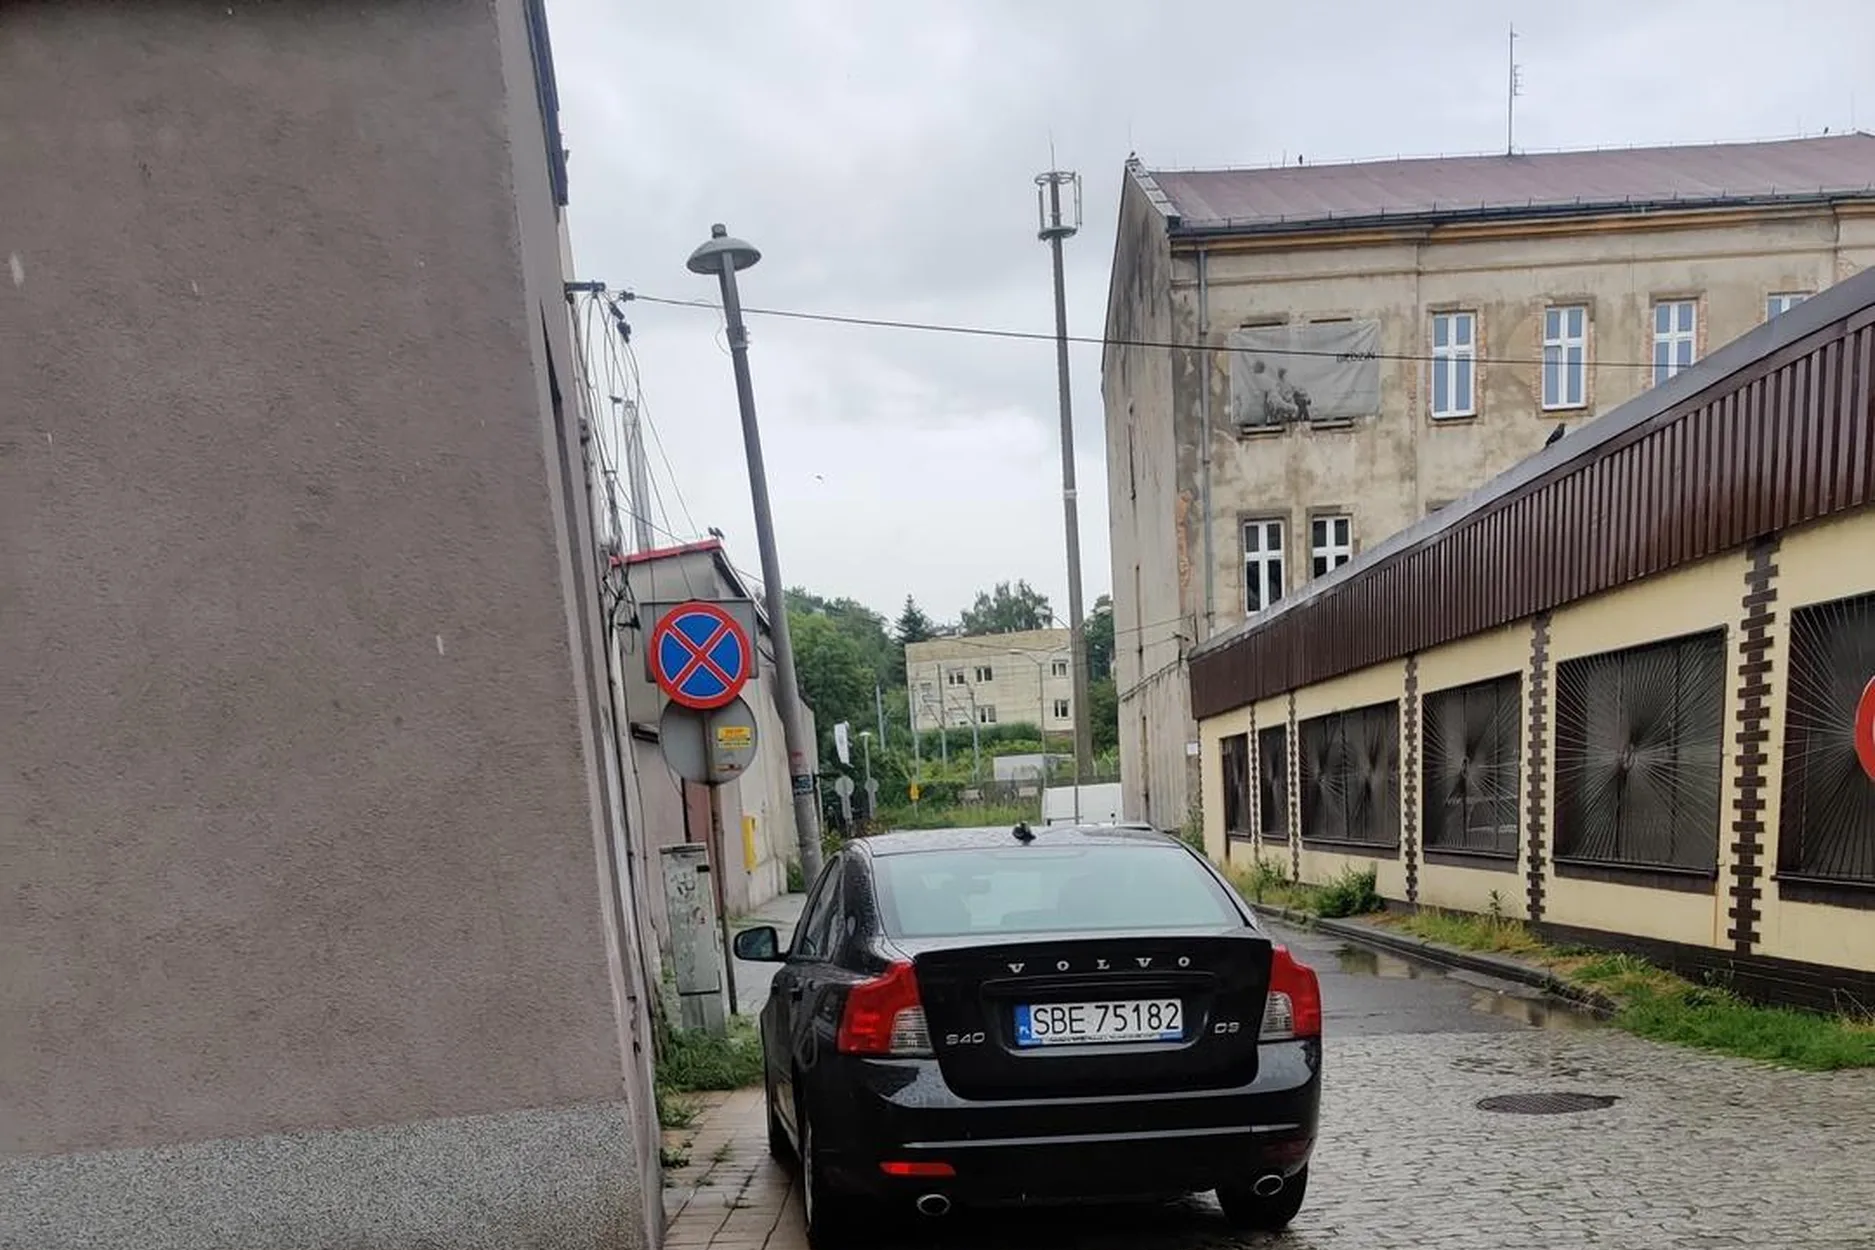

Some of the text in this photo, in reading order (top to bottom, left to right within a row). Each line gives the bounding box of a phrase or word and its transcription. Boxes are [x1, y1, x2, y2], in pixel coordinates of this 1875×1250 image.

[1007, 956, 1191, 974] VOLVO
[1033, 1002, 1180, 1036] SBE 75182
[945, 1032, 985, 1046] S40
